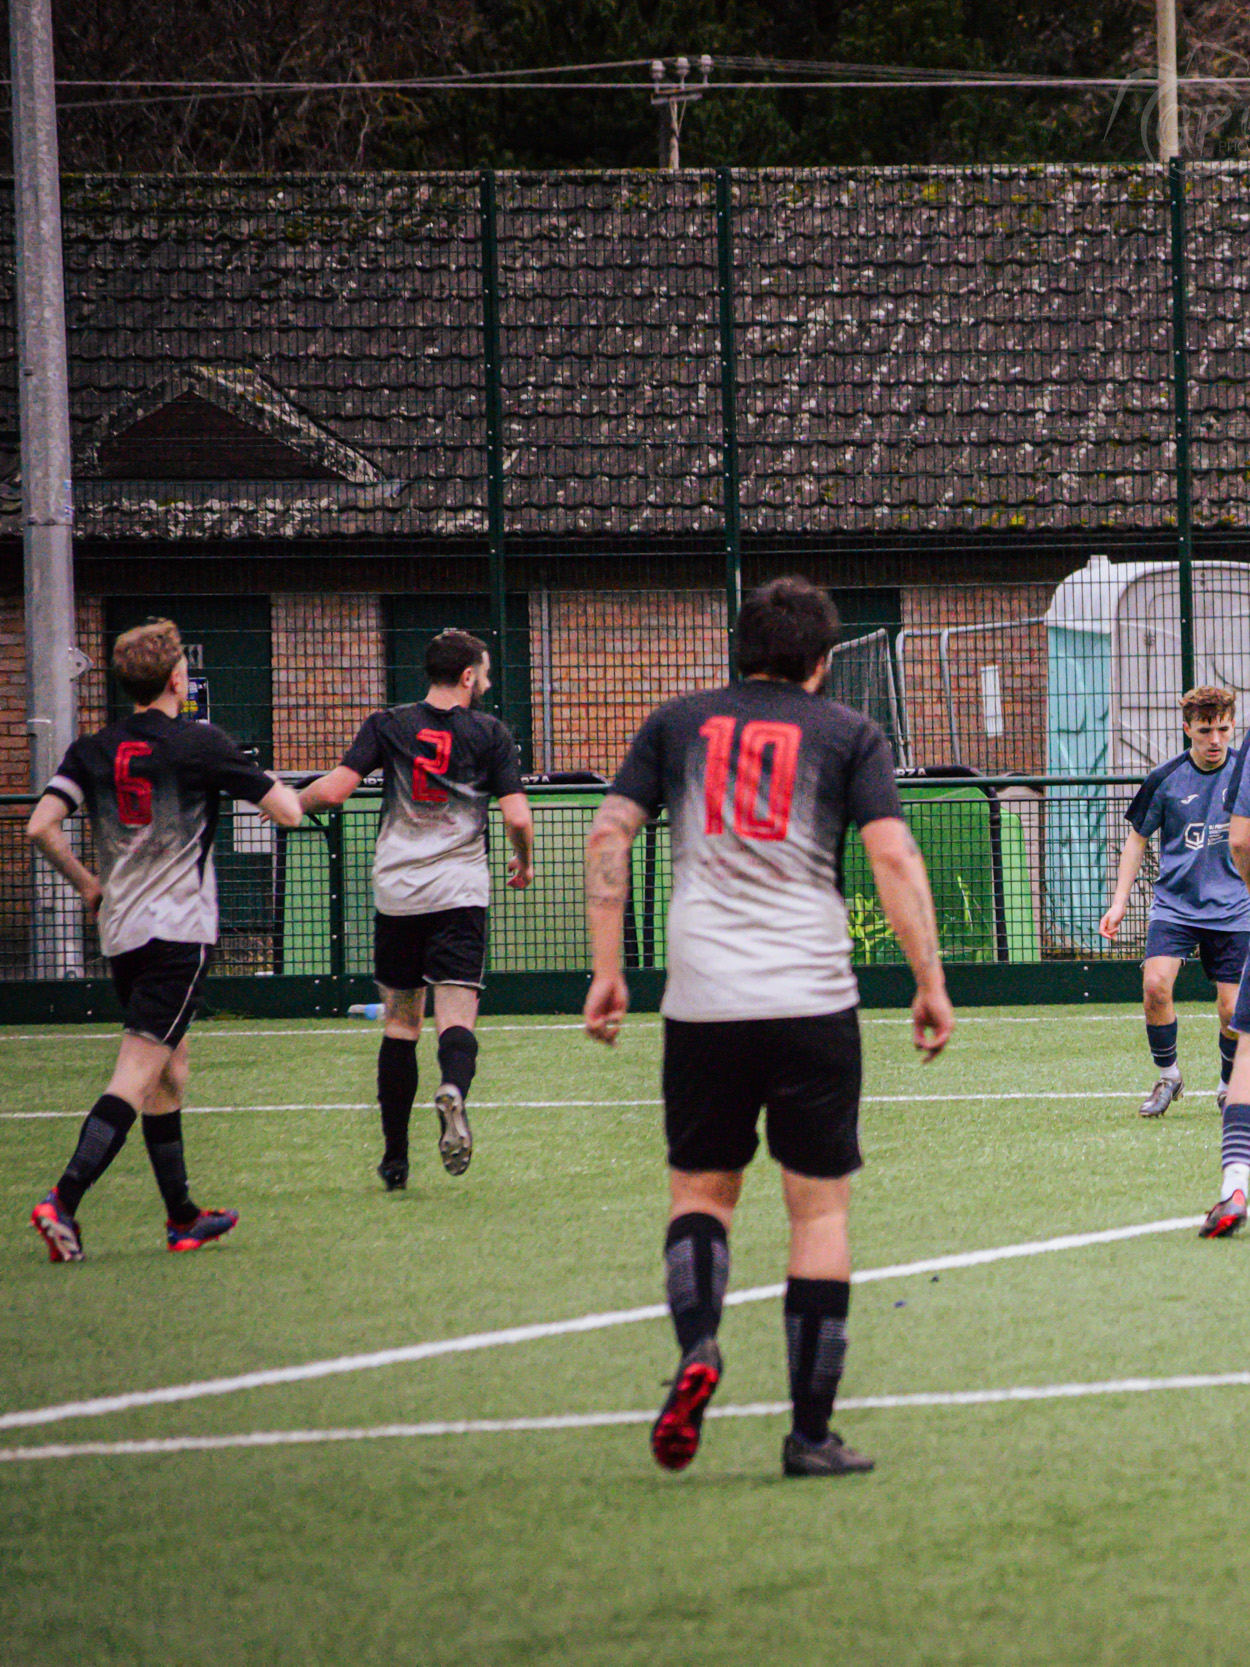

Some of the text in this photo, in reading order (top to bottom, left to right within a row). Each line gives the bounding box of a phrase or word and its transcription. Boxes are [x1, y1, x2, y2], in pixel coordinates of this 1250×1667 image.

[114, 741, 153, 826] 6
[412, 728, 452, 802] 2
[699, 715, 802, 842] 10
